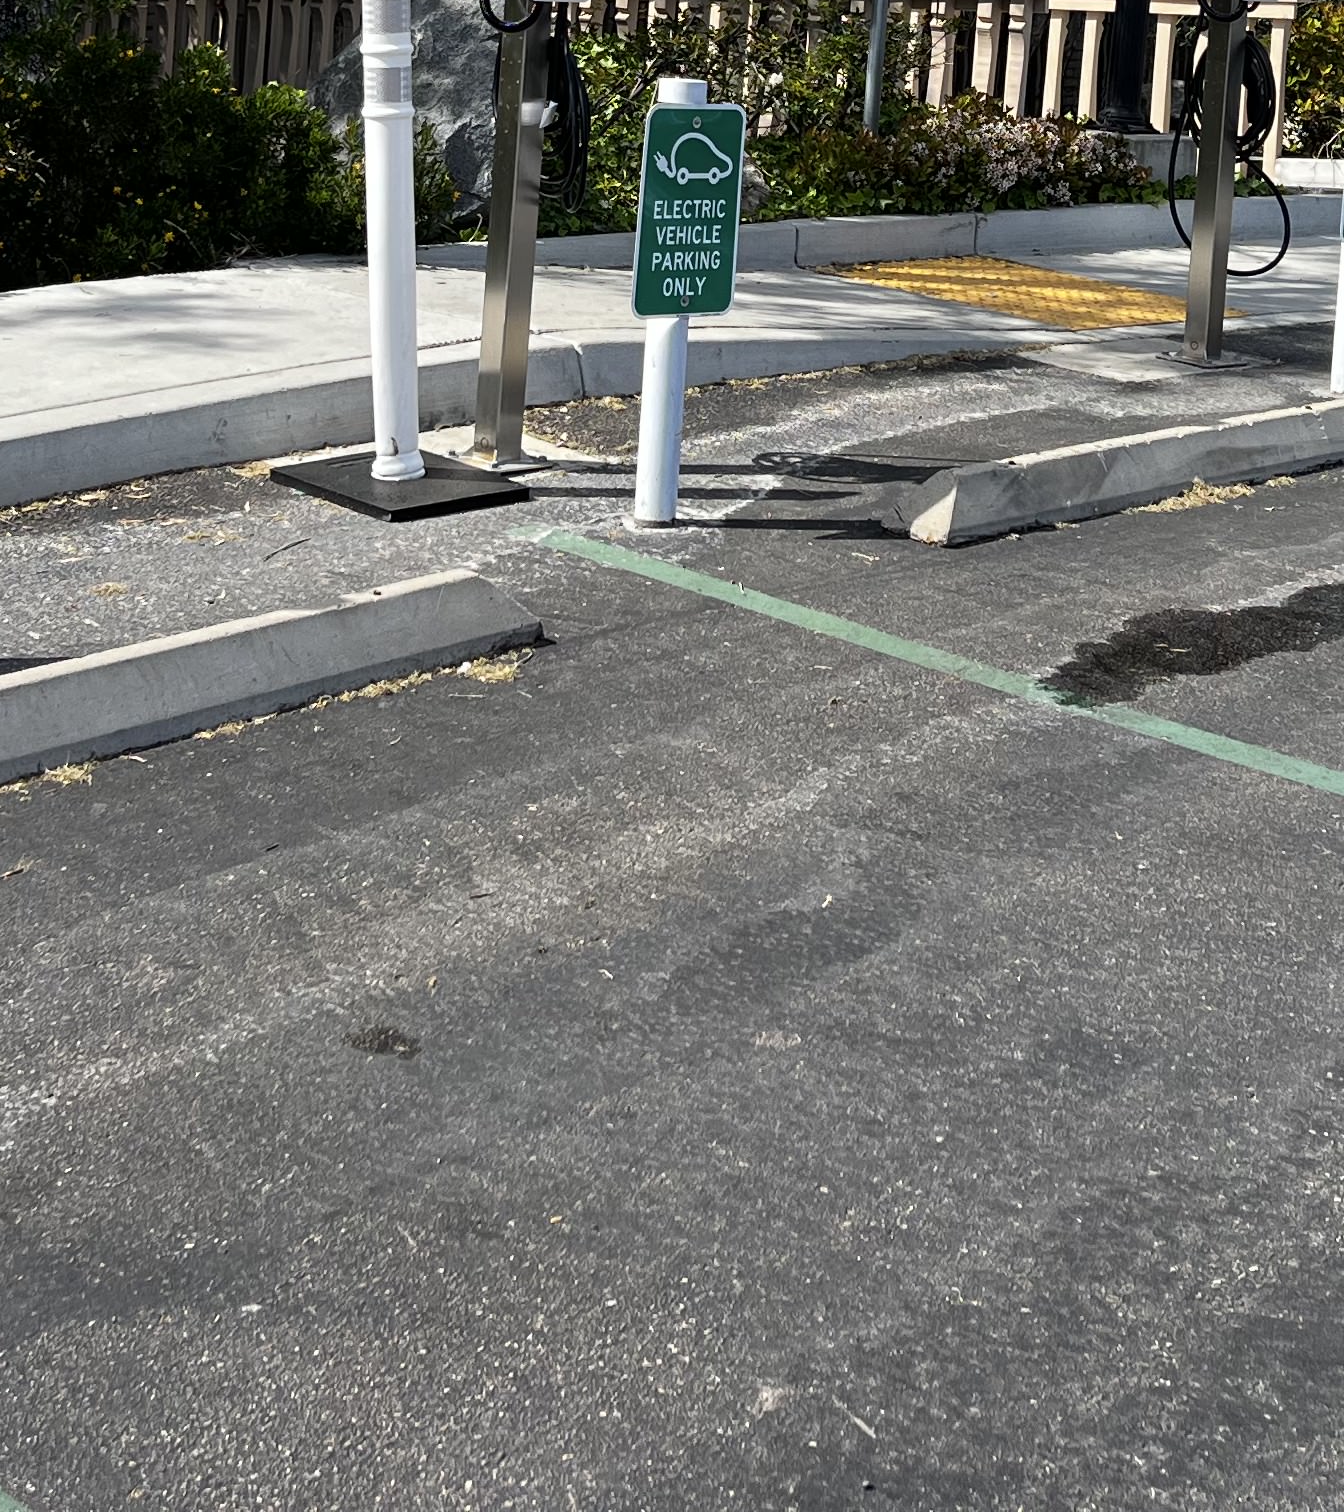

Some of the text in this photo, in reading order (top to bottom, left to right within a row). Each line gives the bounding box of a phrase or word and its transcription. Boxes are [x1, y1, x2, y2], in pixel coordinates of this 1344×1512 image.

[654, 199, 726, 219] ELECTRIC
[656, 225, 722, 245] VEHICLE
[652, 251, 721, 271] PARKING
[663, 277, 706, 297] ONLY
